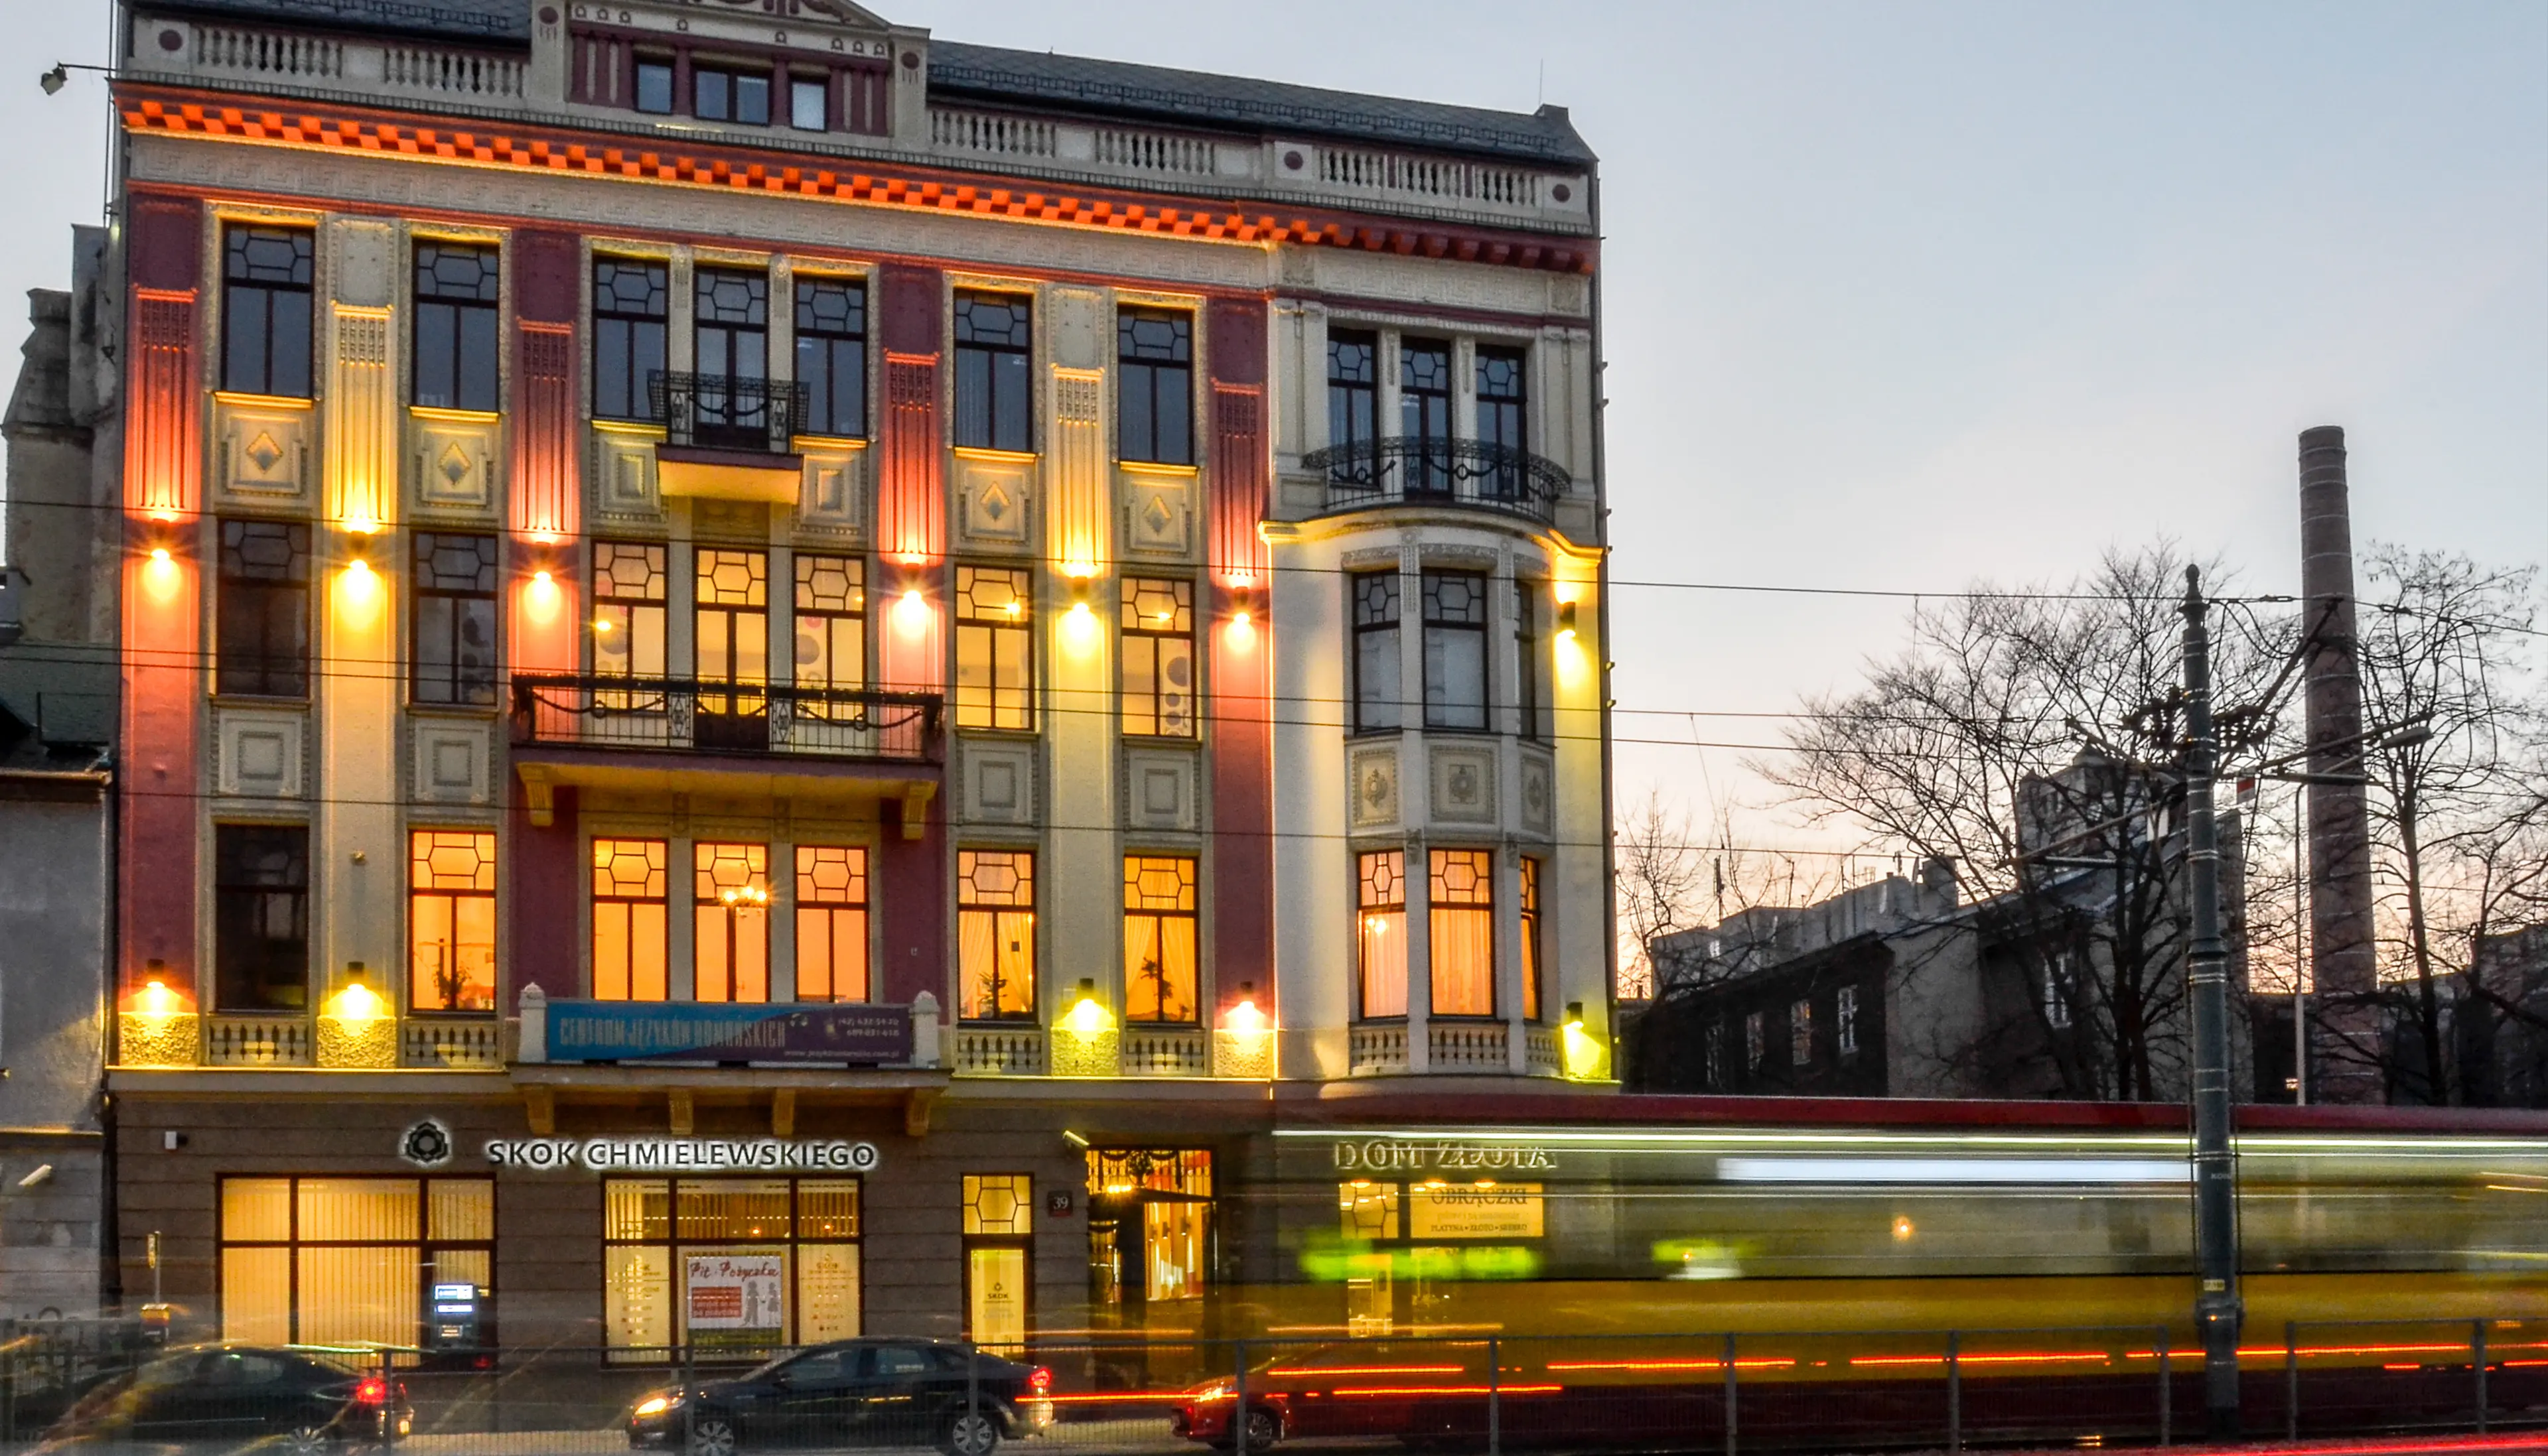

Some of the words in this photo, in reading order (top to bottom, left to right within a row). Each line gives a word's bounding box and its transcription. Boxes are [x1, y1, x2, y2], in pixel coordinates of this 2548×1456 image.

[560, 1018, 624, 1046] CENTRUM
[488, 1142, 576, 1165] SKOK
[587, 1142, 876, 1167] CHMIELEWSKIEGO
[1334, 1140, 1425, 1169] DOM
[1053, 1196, 1068, 1211] 39
[1431, 1188, 1527, 1207] OBRĄCZKI
